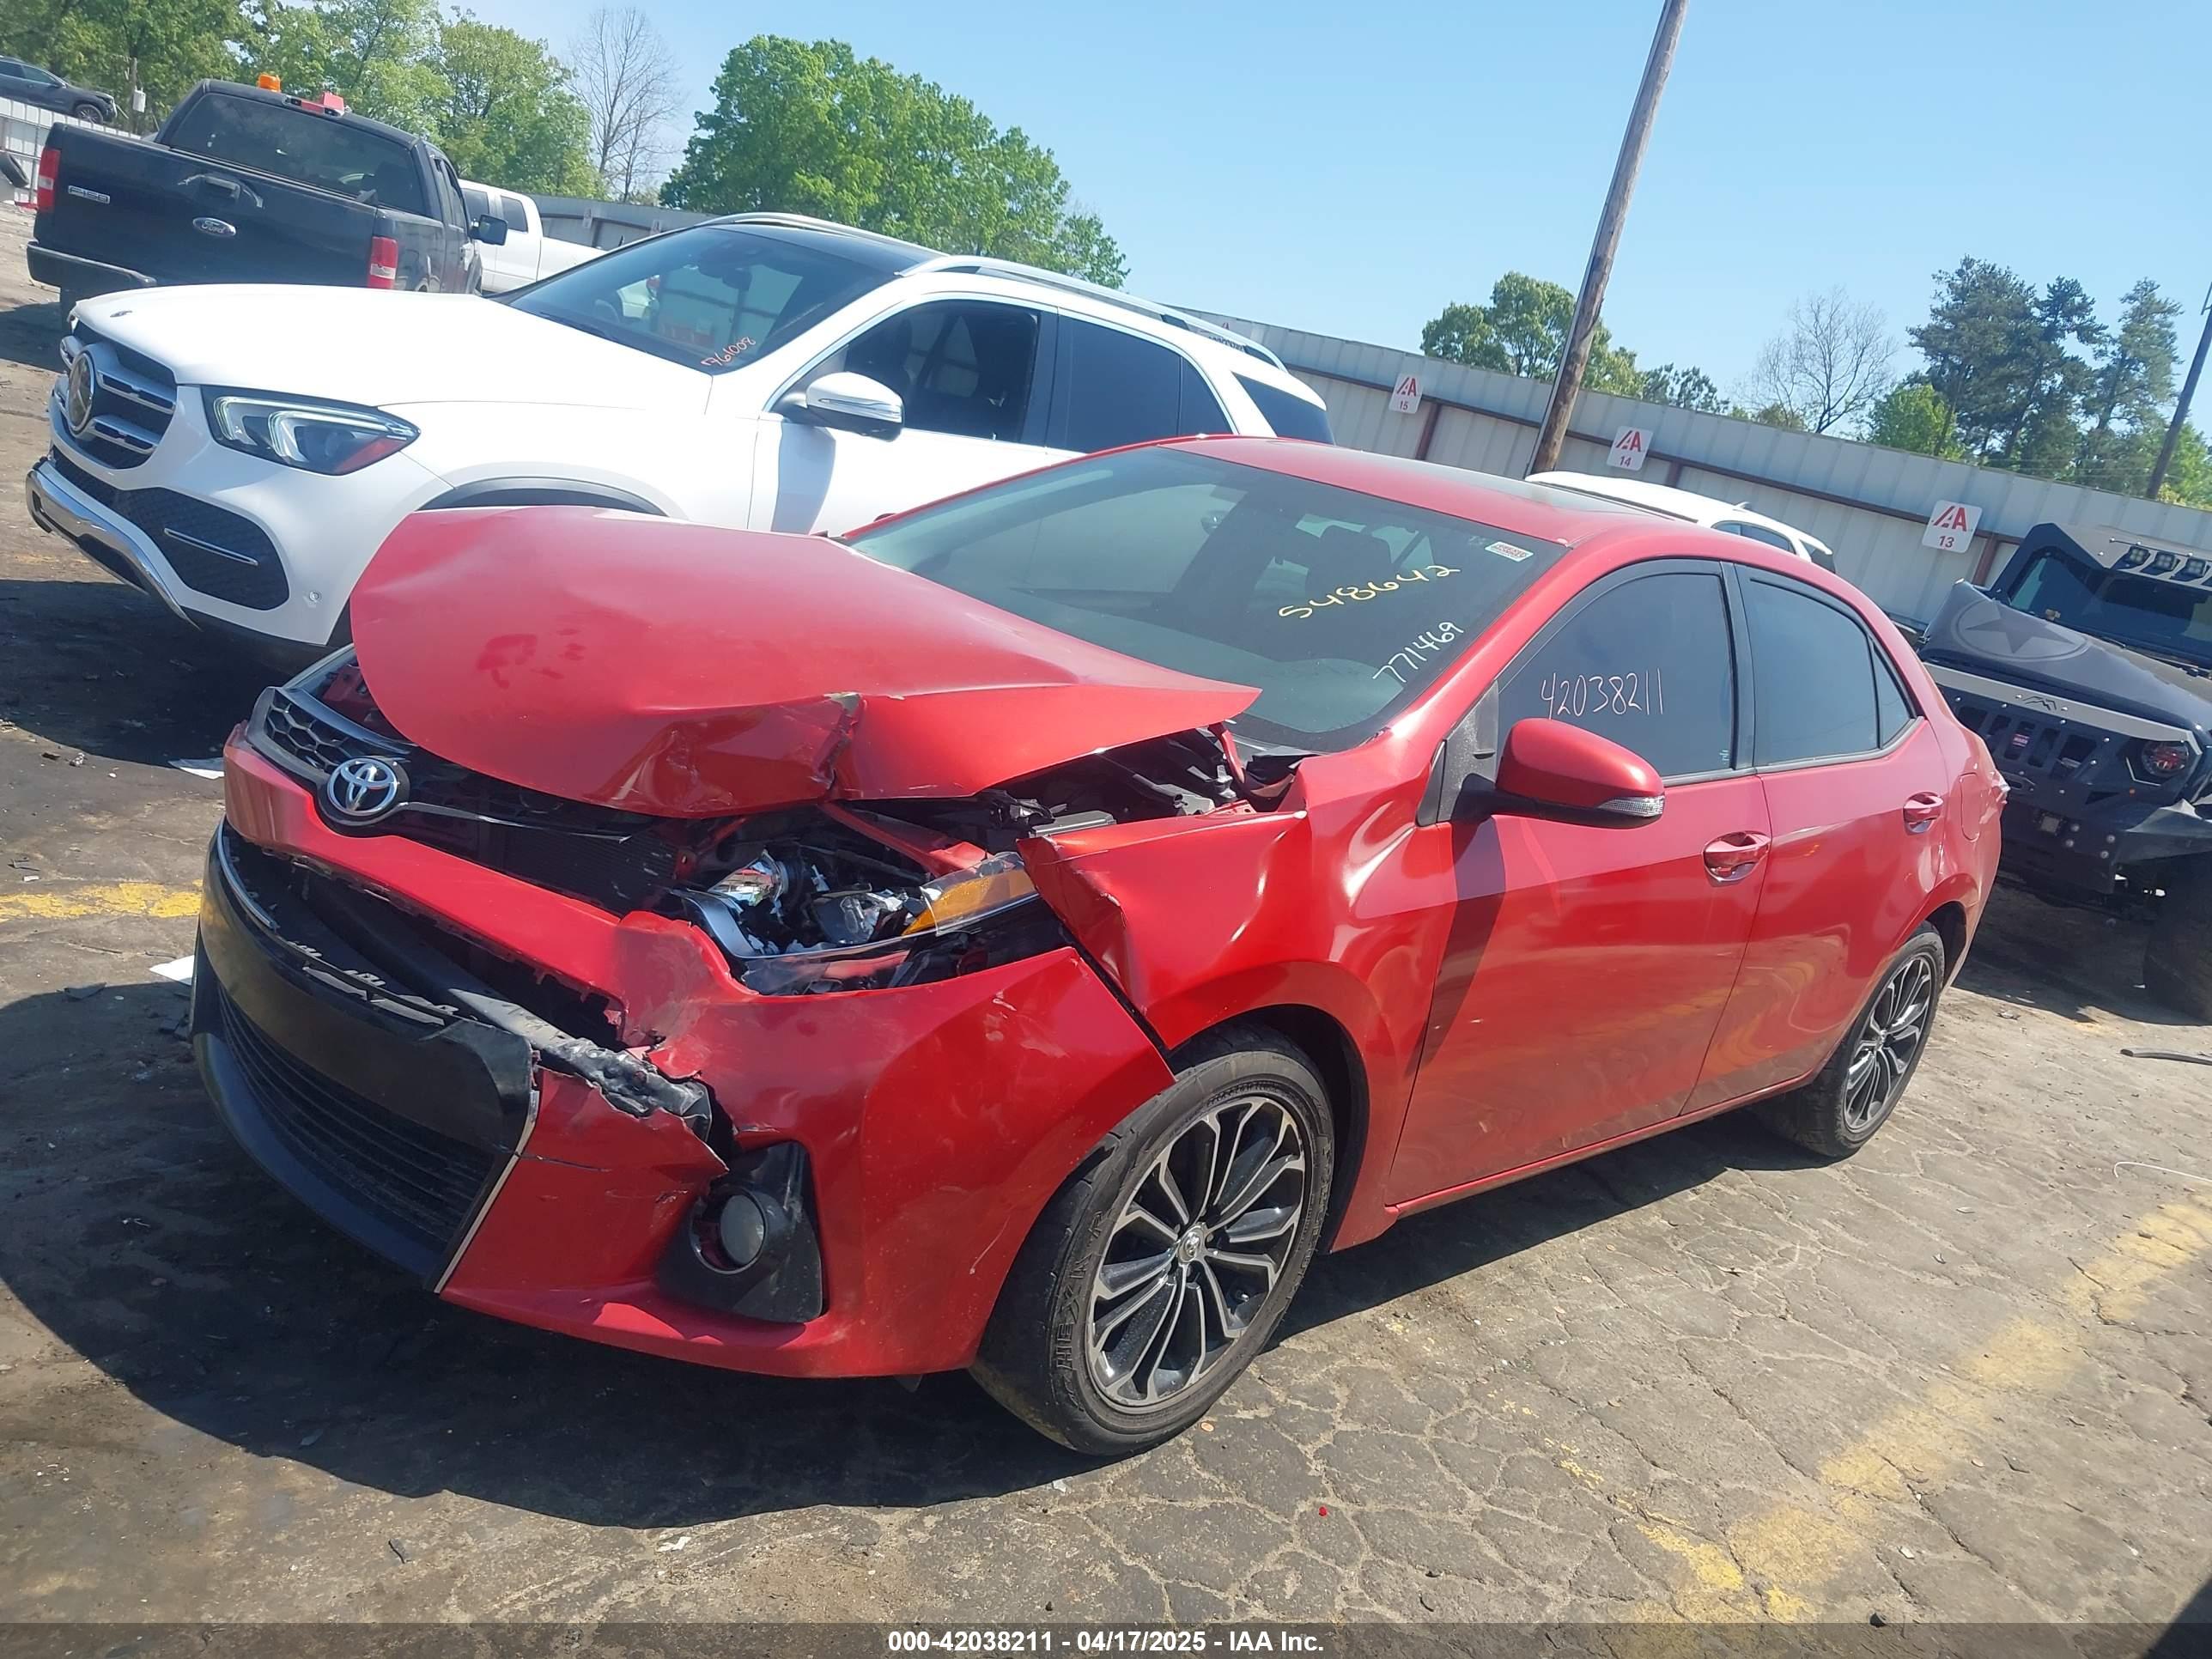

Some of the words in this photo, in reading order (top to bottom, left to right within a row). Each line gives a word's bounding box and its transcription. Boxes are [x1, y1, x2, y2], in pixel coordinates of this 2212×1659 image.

[199, 219, 228, 234] Ford
[1400, 400, 1409, 410] 15
[1620, 456, 1632, 467] 14
[1939, 535, 1954, 548] 13
[1279, 564, 1460, 618] 548642
[1372, 621, 1464, 683] 771469
[1540, 667, 1665, 720] 42038211
